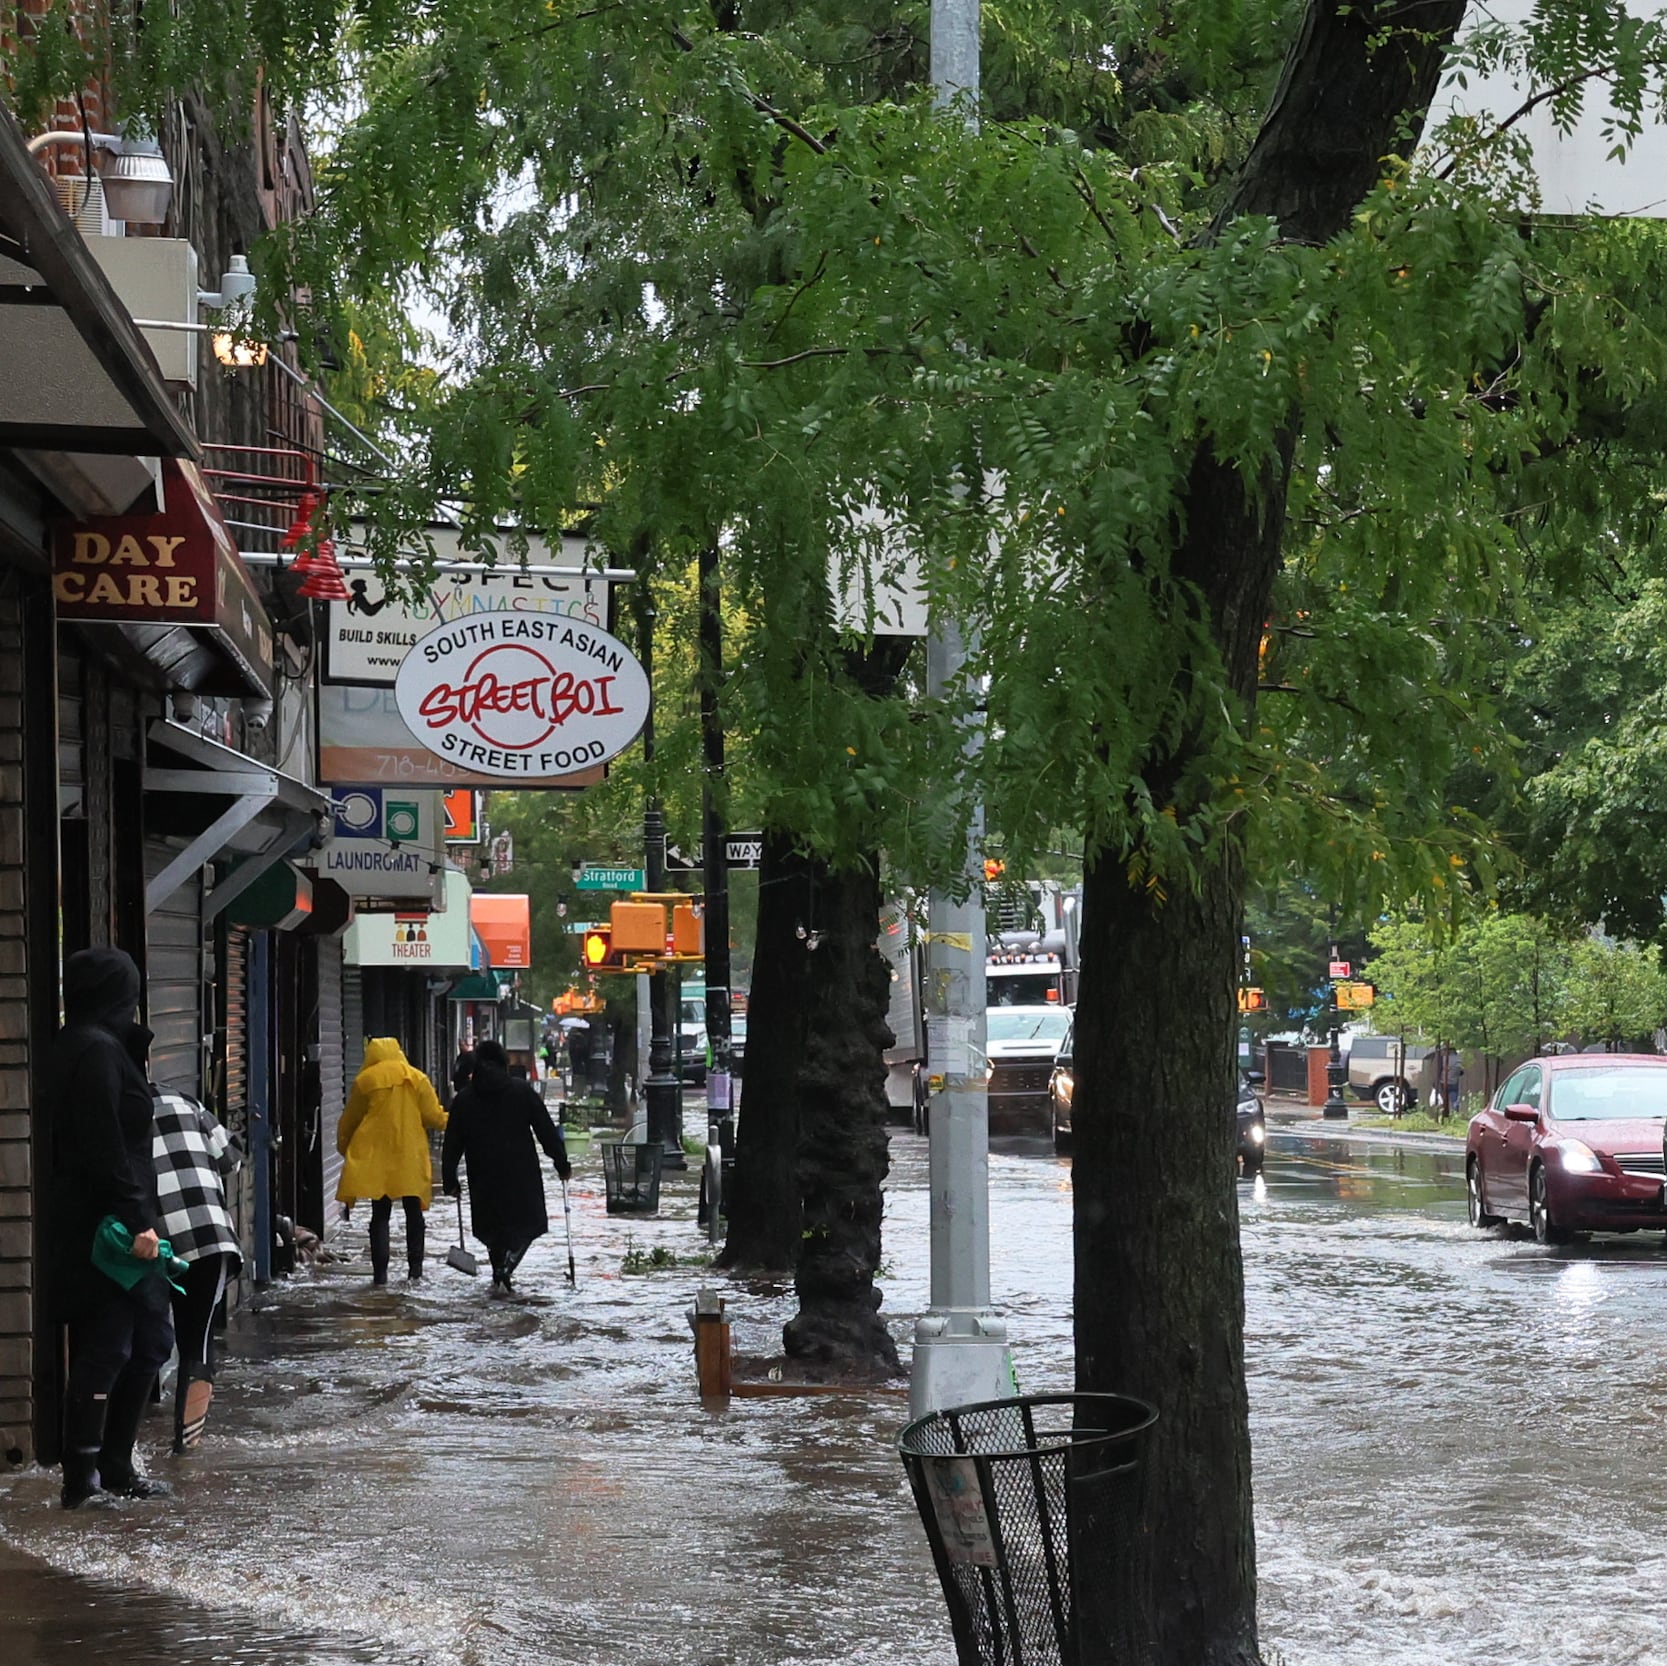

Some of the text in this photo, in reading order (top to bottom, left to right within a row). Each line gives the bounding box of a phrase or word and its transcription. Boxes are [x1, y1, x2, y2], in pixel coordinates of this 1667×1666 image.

[71, 532, 186, 568] DAY
[54, 571, 199, 608] CARE
[339, 628, 417, 646] BUILD SKILLS
[423, 619, 623, 673] SOUTH EAST ASIAN
[441, 733, 606, 771] STREET FOOD
[729, 844, 762, 858] WAY
[327, 852, 420, 873] LAUNDROMAT
[583, 870, 635, 883] Stratford
[392, 943, 431, 958] THEATER
